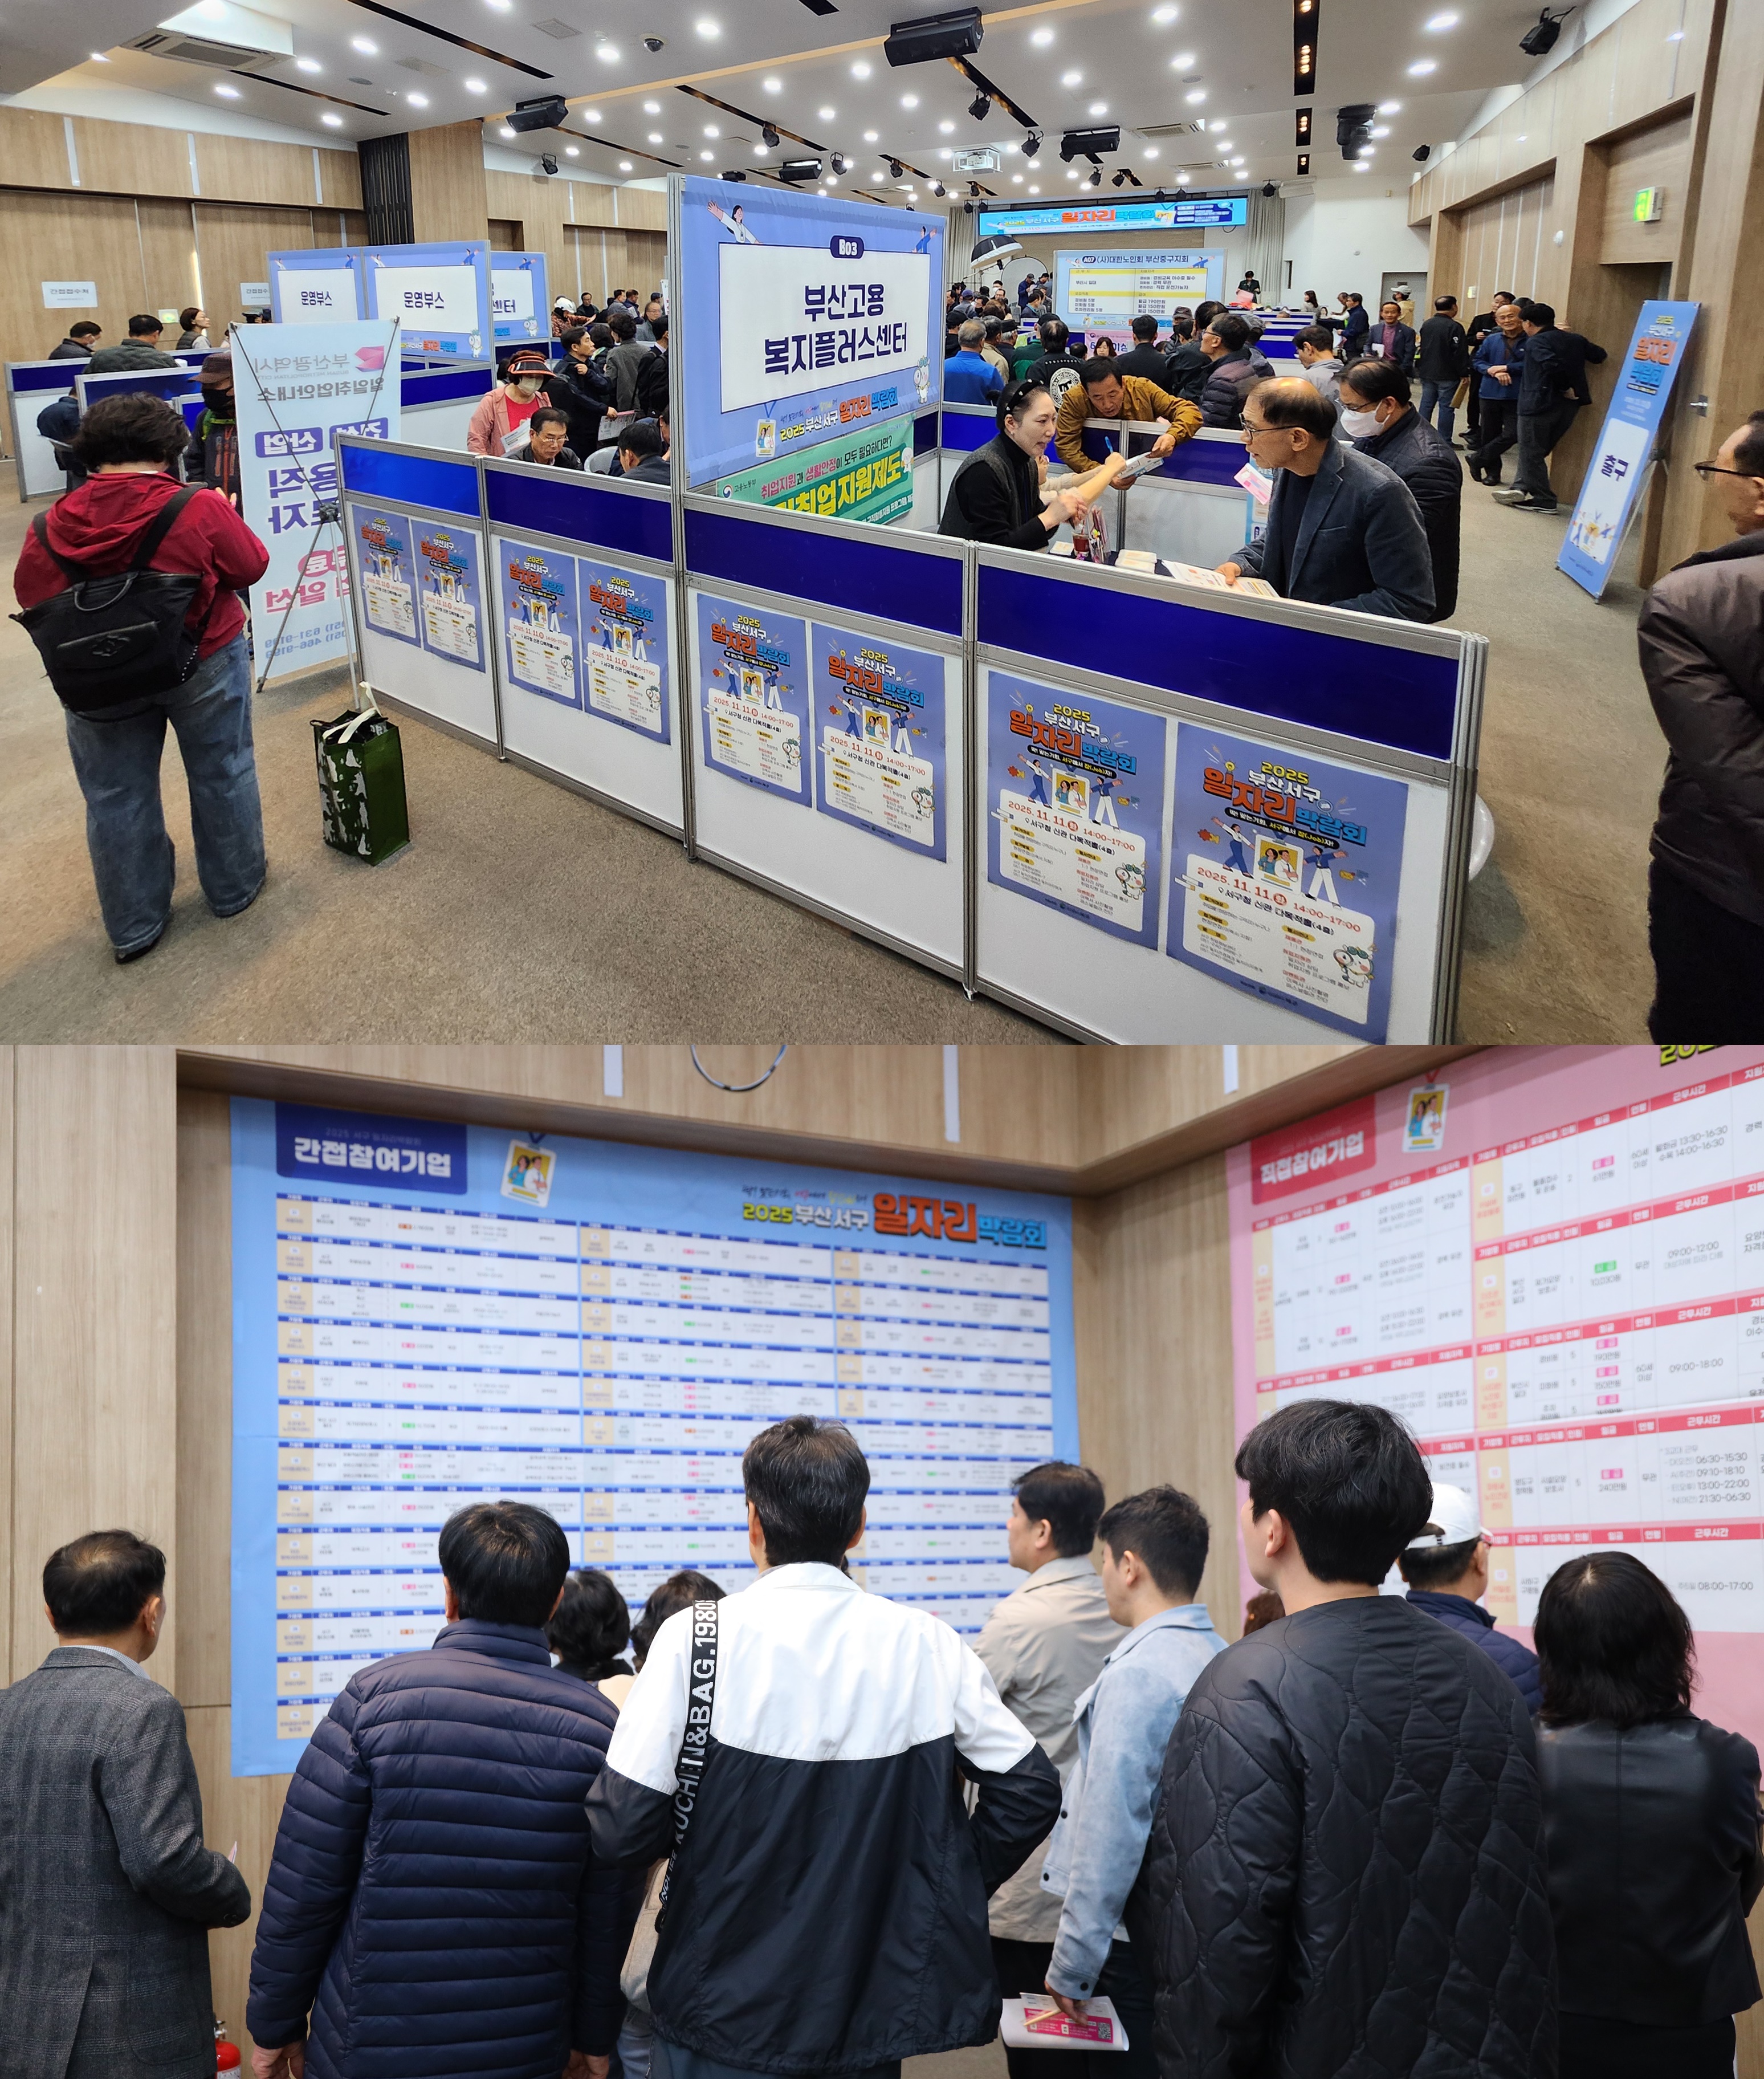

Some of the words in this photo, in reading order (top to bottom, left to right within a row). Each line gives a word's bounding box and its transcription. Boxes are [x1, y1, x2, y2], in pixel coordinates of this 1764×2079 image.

[1061, 209, 1115, 223] 일자리
[839, 238, 858, 255] B03
[301, 291, 332, 307] 운영부스
[404, 291, 445, 310] 운영부스
[804, 284, 885, 322] 부산고용
[764, 322, 907, 375] 복지플러스센터
[1633, 336, 1679, 365] 일자리
[780, 422, 805, 441] 2025
[840, 394, 871, 423] 일자리
[871, 387, 899, 411] 박람회
[761, 472, 804, 499] 취업지원과
[805, 458, 842, 482] 생활안정이
[844, 450, 857, 465] 모두
[859, 435, 893, 459] 필요하다면?
[523, 562, 549, 575] 부산서구
[527, 555, 544, 565] 2025
[509, 563, 542, 589] 일자리
[611, 576, 630, 588] 2025
[606, 583, 635, 599] 부산서구
[589, 584, 627, 615] 일자리
[626, 604, 654, 622] 박람회
[732, 622, 767, 640] 부산서구
[738, 615, 760, 628] 2025
[711, 623, 757, 658] 일자리
[756, 645, 791, 667] 박람회
[861, 648, 889, 662] 2025
[854, 655, 896, 677] 부산서구
[828, 654, 883, 695] 일자리
[882, 681, 924, 708] 박람회
[1053, 703, 1091, 722] 2025
[1044, 710, 1101, 738] 부산서구
[830, 735, 850, 748] 2025.
[1009, 709, 1082, 758] 일자리
[1082, 741, 1136, 776] 박람회
[1261, 761, 1309, 784] 2025
[1249, 770, 1321, 804] 부산서구
[1008, 800, 1034, 816] 2025.
[1203, 767, 1296, 825] 일자리
[1295, 806, 1367, 847] 박람회
[1030, 818, 1051, 832] 서구청
[1053, 828, 1068, 839] 신관
[1197, 866, 1230, 885] 2025.
[1225, 889, 1251, 905] 서구청
[1254, 900, 1273, 913] 신관
[1673, 1084, 1706, 1102] 근무시간
[294, 1136, 451, 1178] 간접참여기업
[1260, 1130, 1364, 1185] 직접참여기업
[1675, 1194, 1709, 1211] 근무시간
[743, 1203, 793, 1224] 2025
[873, 1193, 977, 1242] 일자리
[978, 1214, 1048, 1249] 박람회
[1677, 1306, 1712, 1321] 근무시간
[1687, 1414, 1721, 1427] 근무시간
[1599, 1483, 1627, 1492] 240만원
[1694, 1527, 1729, 1538] 근무시간
